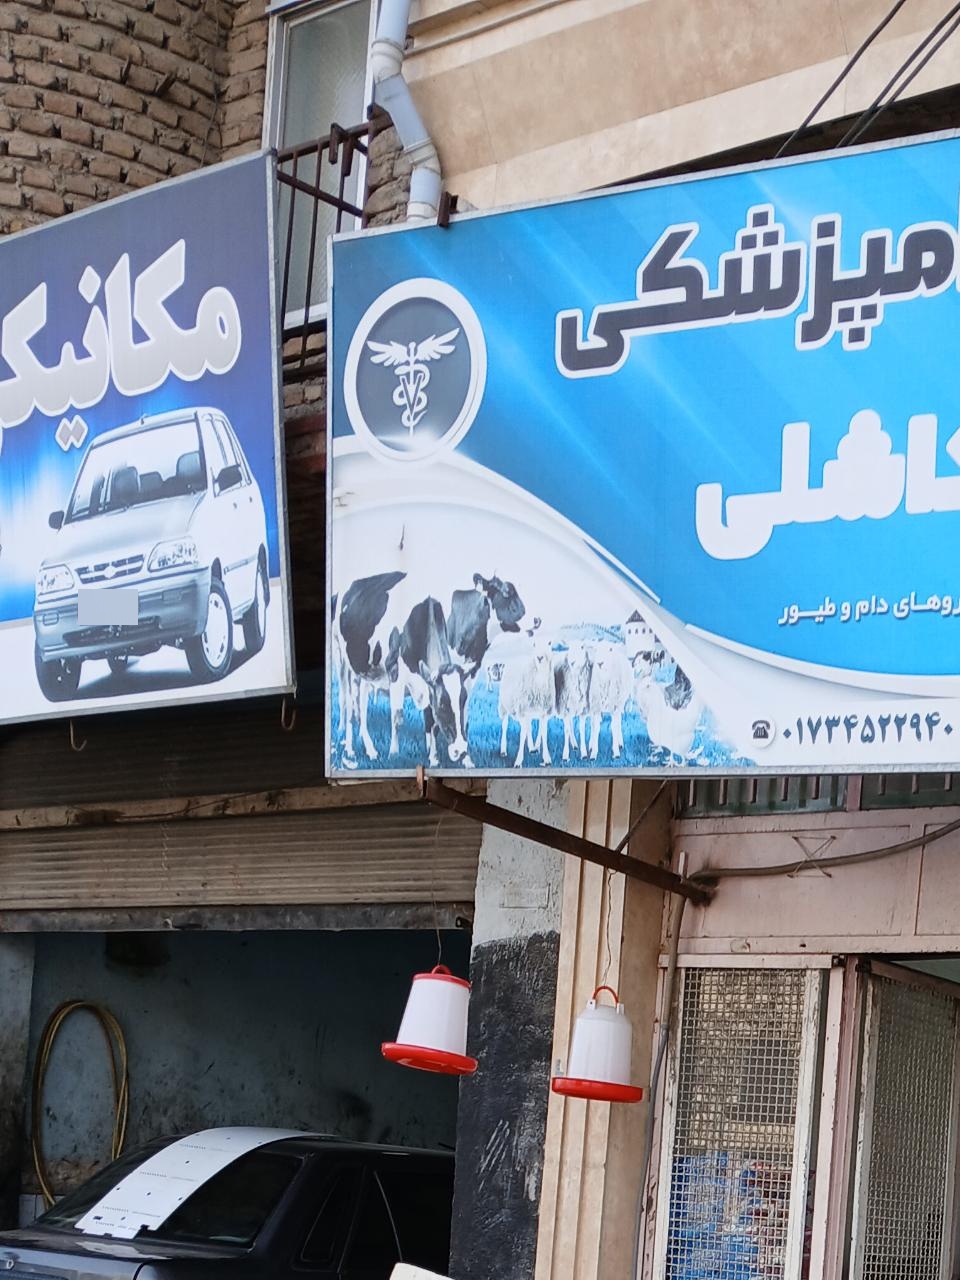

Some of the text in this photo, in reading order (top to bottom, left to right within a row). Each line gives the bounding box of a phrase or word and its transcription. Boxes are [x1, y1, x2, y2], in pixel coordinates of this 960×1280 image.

[777, 596, 836, 625] طیور
[840, 601, 850, 621] و
[855, 595, 888, 621] دام
[782, 709, 954, 745] ۰۱۷۳۴۵۲۲۹۴۰
